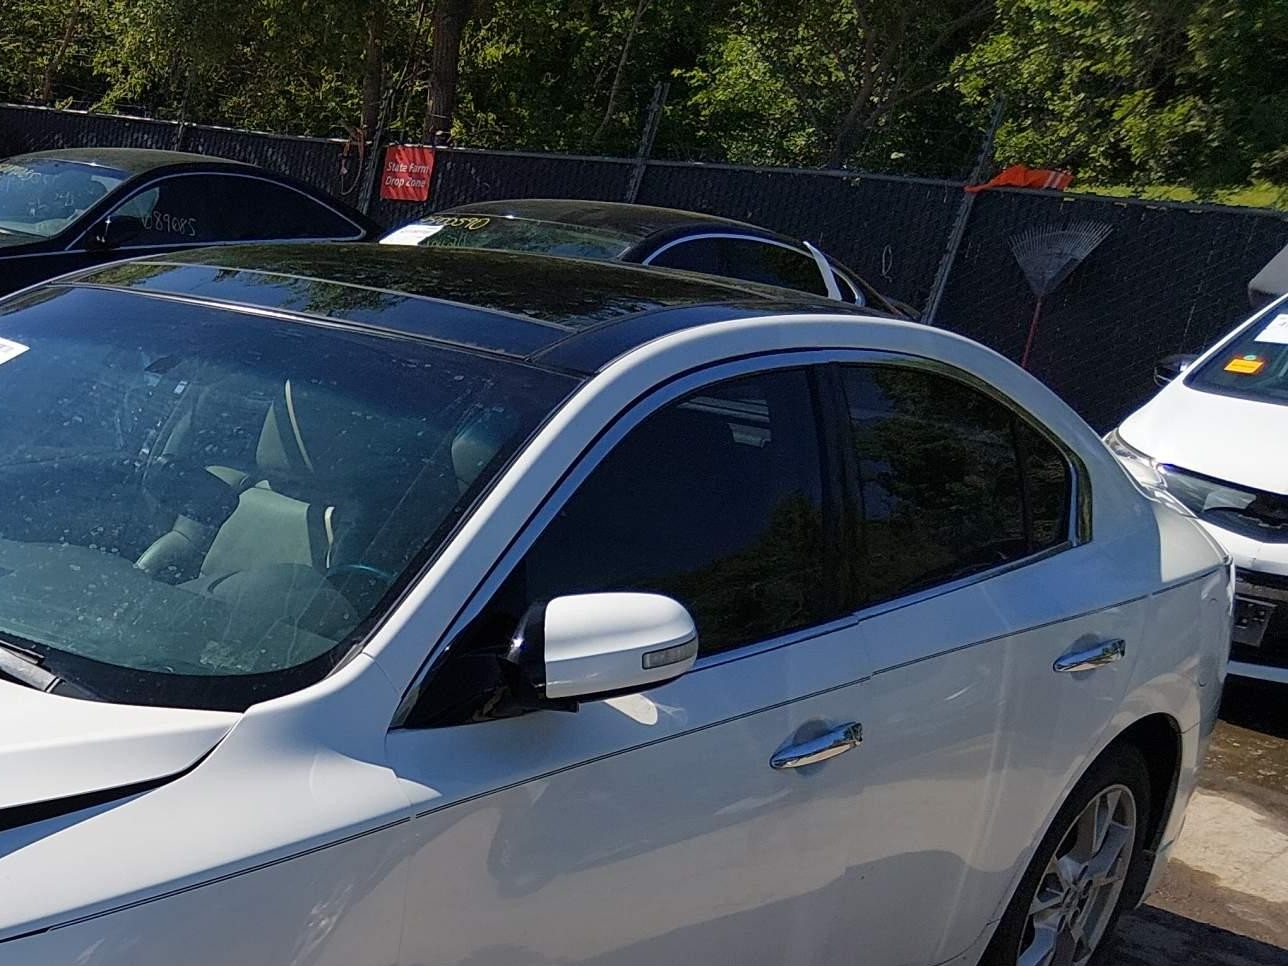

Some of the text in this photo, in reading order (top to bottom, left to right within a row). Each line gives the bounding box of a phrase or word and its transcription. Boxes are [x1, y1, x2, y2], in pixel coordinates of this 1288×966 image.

[386, 161, 429, 174] State Farm
[385, 175, 426, 188] Drop Zone
